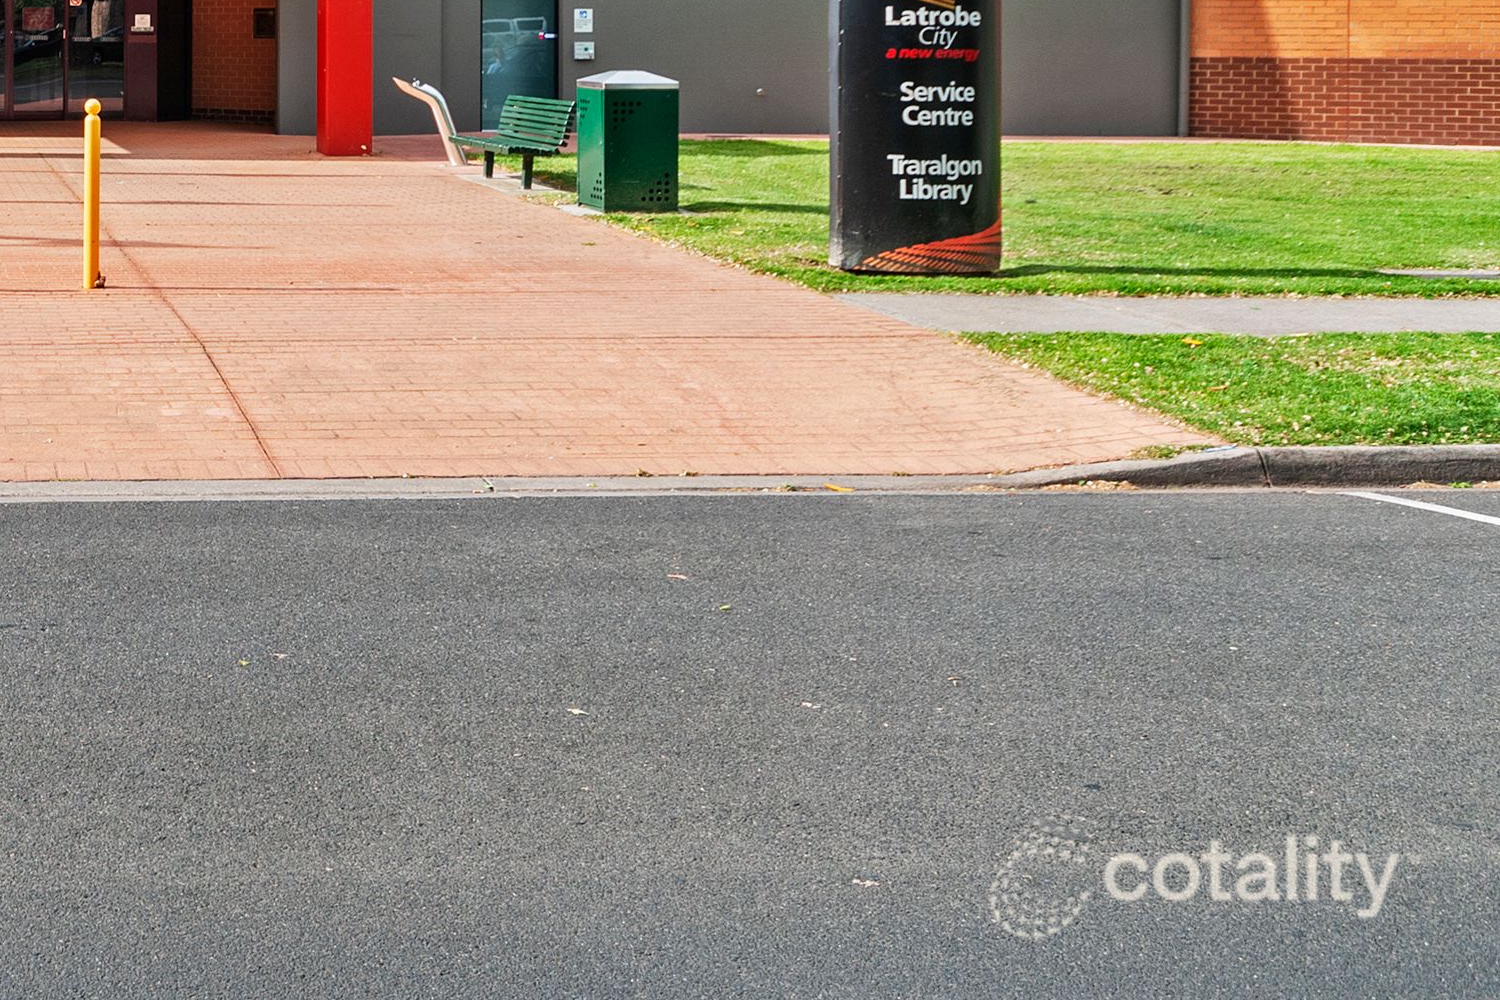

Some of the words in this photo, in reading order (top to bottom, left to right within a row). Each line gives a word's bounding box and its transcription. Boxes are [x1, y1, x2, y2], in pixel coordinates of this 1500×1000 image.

[885, 5, 981, 26] Latrobe
[918, 26, 958, 49] City
[885, 47, 897, 59] a
[899, 47, 933, 58] new
[935, 48, 980, 62] energy
[900, 80, 975, 102] Service
[902, 105, 973, 126] Centre
[886, 154, 982, 180] Traralgon
[900, 178, 973, 205] Library
